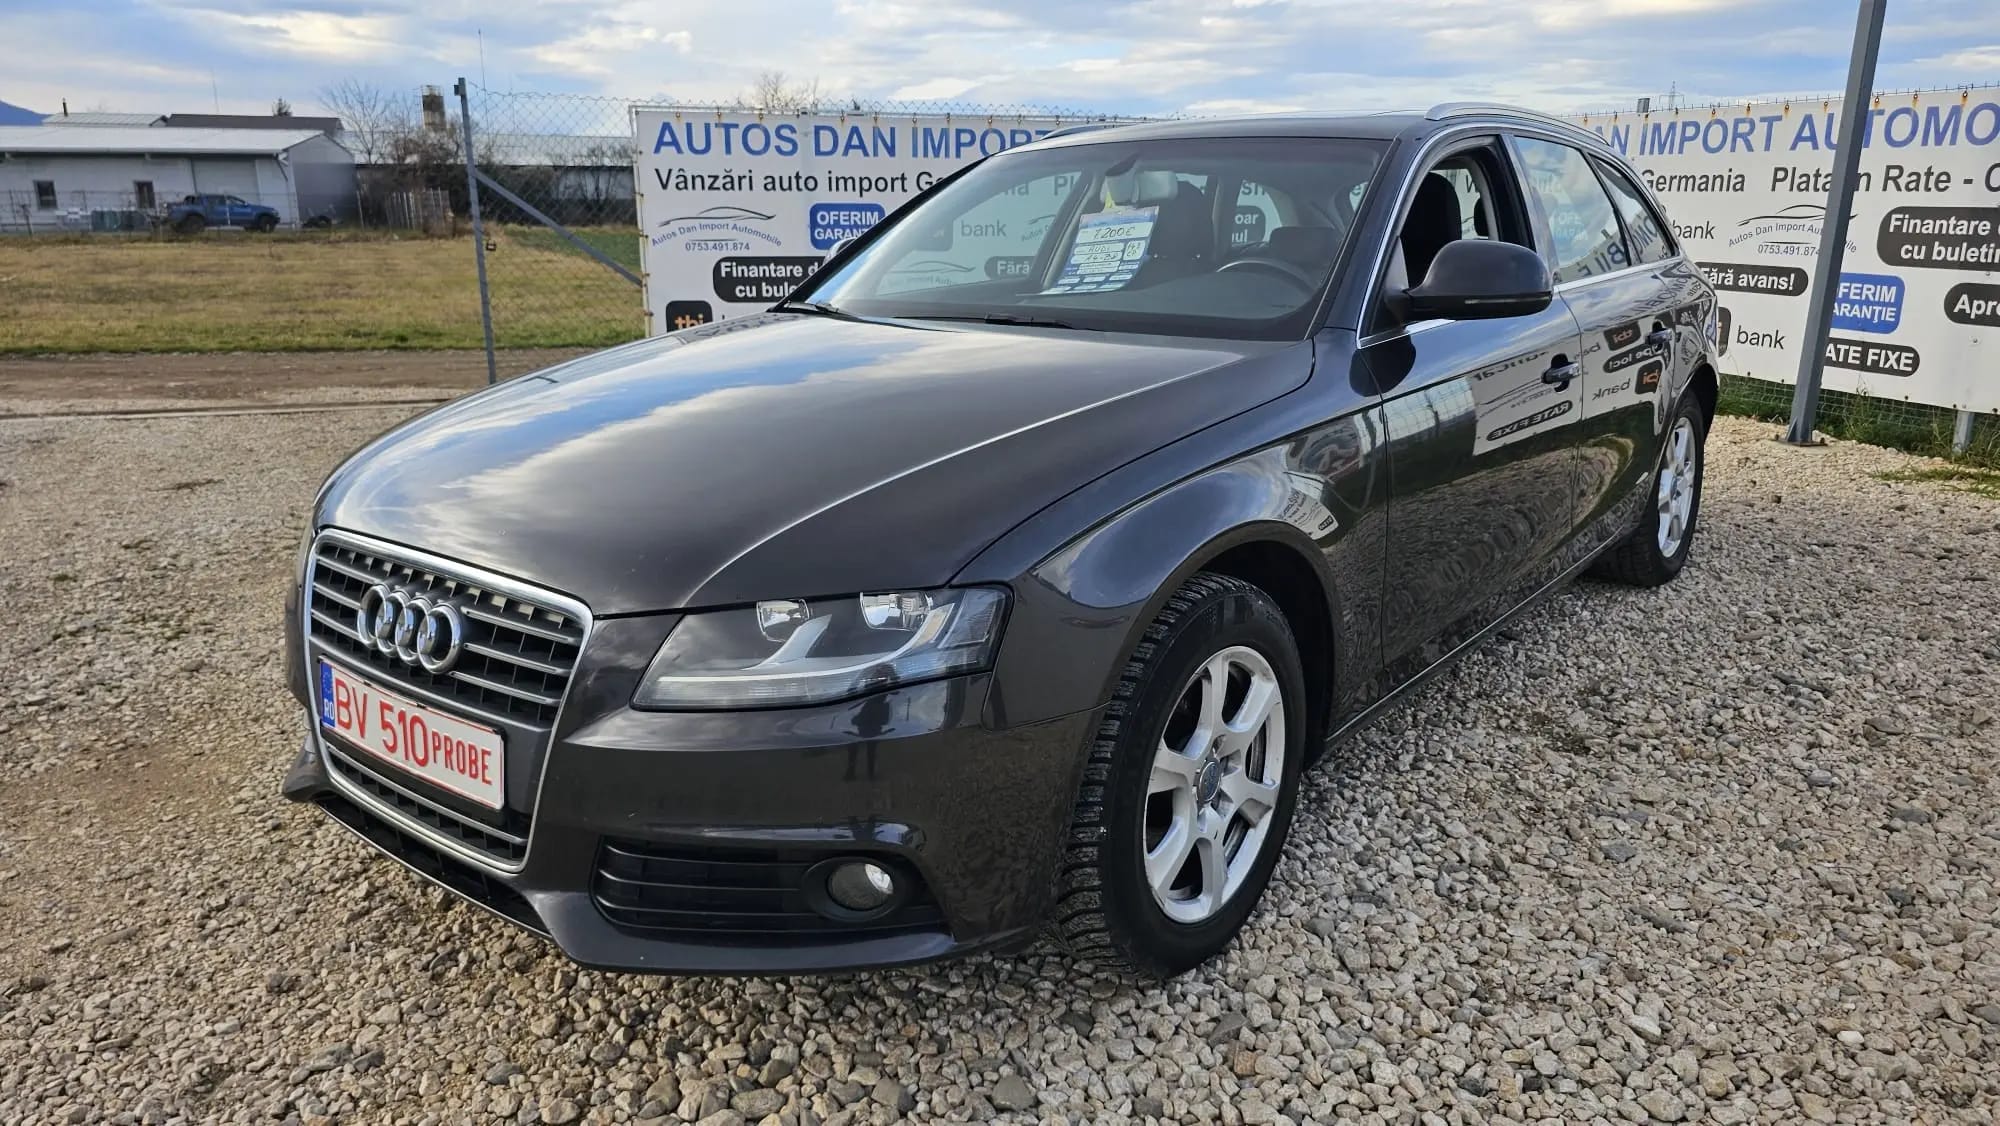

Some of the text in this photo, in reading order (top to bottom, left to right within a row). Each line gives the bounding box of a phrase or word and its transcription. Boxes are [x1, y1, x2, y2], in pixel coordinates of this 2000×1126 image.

[653, 121, 799, 157] AUTOS
[814, 125, 896, 158] DAN
[1639, 115, 1783, 156] IMPORT
[655, 168, 753, 192] Vânzări
[763, 170, 818, 192] auto
[828, 170, 907, 197] import
[1642, 168, 1746, 193] Germania
[1882, 165, 1951, 192] Rate
[817, 211, 879, 225] OFERIM
[961, 219, 1007, 237] bank
[1889, 213, 1991, 235] Finantare
[652, 223, 782, 247] Autos Dan Import Automobile
[1672, 220, 1716, 240] bank
[1728, 231, 1753, 247] Autos
[1755, 226, 1773, 236] Dan
[1775, 223, 1805, 234] Import
[685, 242, 750, 252] 0753.491.874
[1900, 244, 1927, 260] cu
[721, 262, 803, 278] Finantare
[735, 285, 757, 298] cu
[1738, 273, 1796, 291] avans!
[1837, 283, 1897, 303] FERIM
[1736, 325, 1785, 350] bank
[1866, 349, 1914, 371] FIXE
[323, 700, 335, 720] RO
[335, 677, 492, 786] BV 510 PROBE
